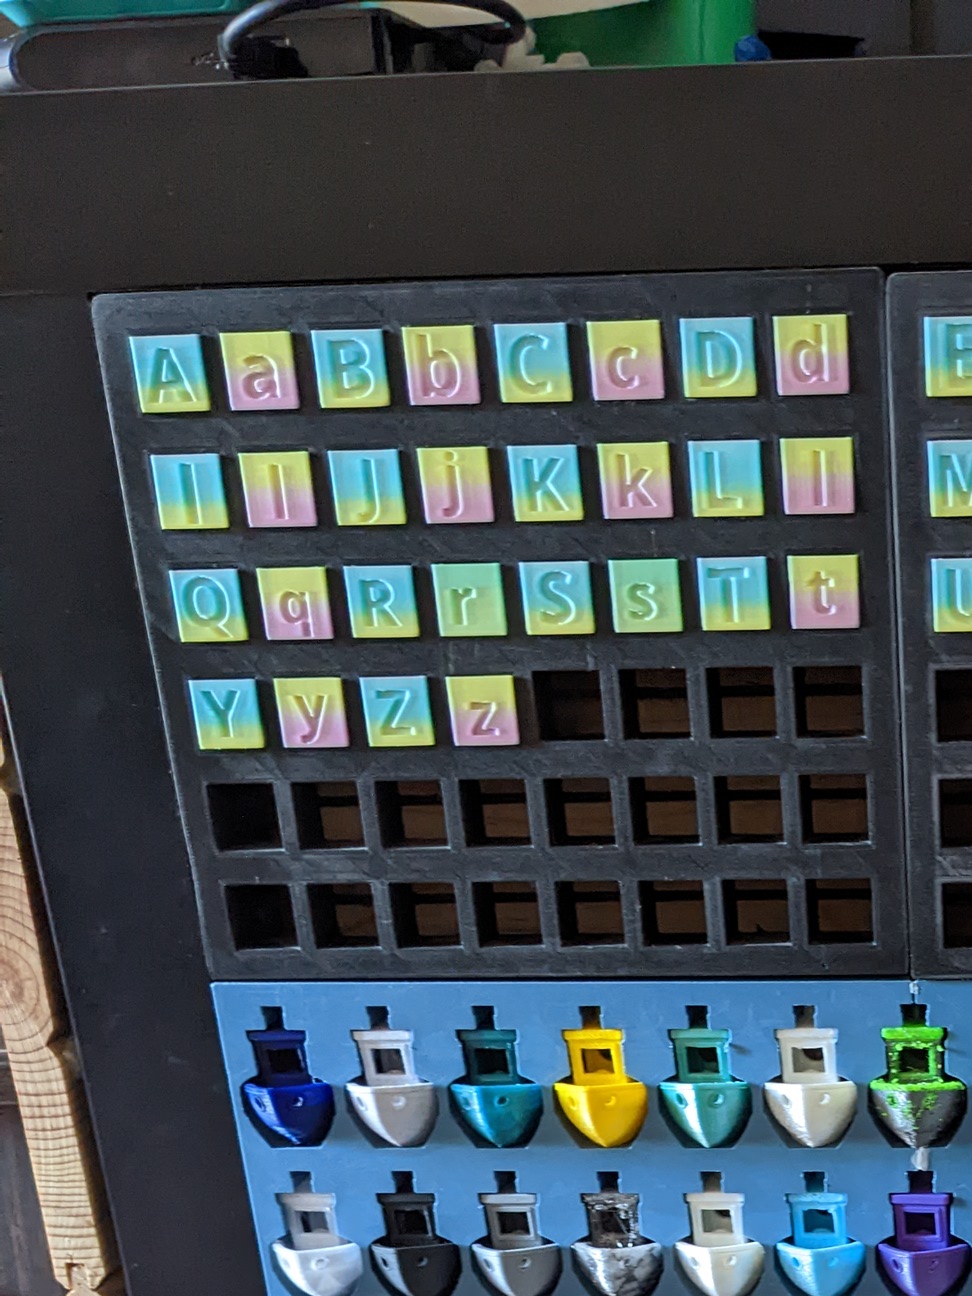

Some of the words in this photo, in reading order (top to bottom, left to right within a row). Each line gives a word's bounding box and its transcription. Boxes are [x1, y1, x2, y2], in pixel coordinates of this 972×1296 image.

[146, 348, 197, 404] A
[242, 353, 281, 399] a
[328, 338, 375, 399] B
[417, 332, 461, 398] b
[508, 334, 552, 395] C
[608, 346, 639, 389] c
[696, 331, 742, 388] D
[790, 323, 829, 384] d
[441, 450, 464, 519] j
[522, 457, 570, 512] K
[616, 453, 657, 508] k
[700, 451, 742, 509] L
[182, 575, 234, 638] Q
[279, 590, 314, 638] q
[359, 578, 402, 627] R
[450, 587, 477, 626] r
[539, 570, 576, 625] S
[706, 567, 749, 623] T
[806, 571, 836, 615] t
[202, 689, 241, 738] Y
[295, 695, 328, 744] y
[376, 690, 416, 736] Z
[466, 701, 499, 736] z
